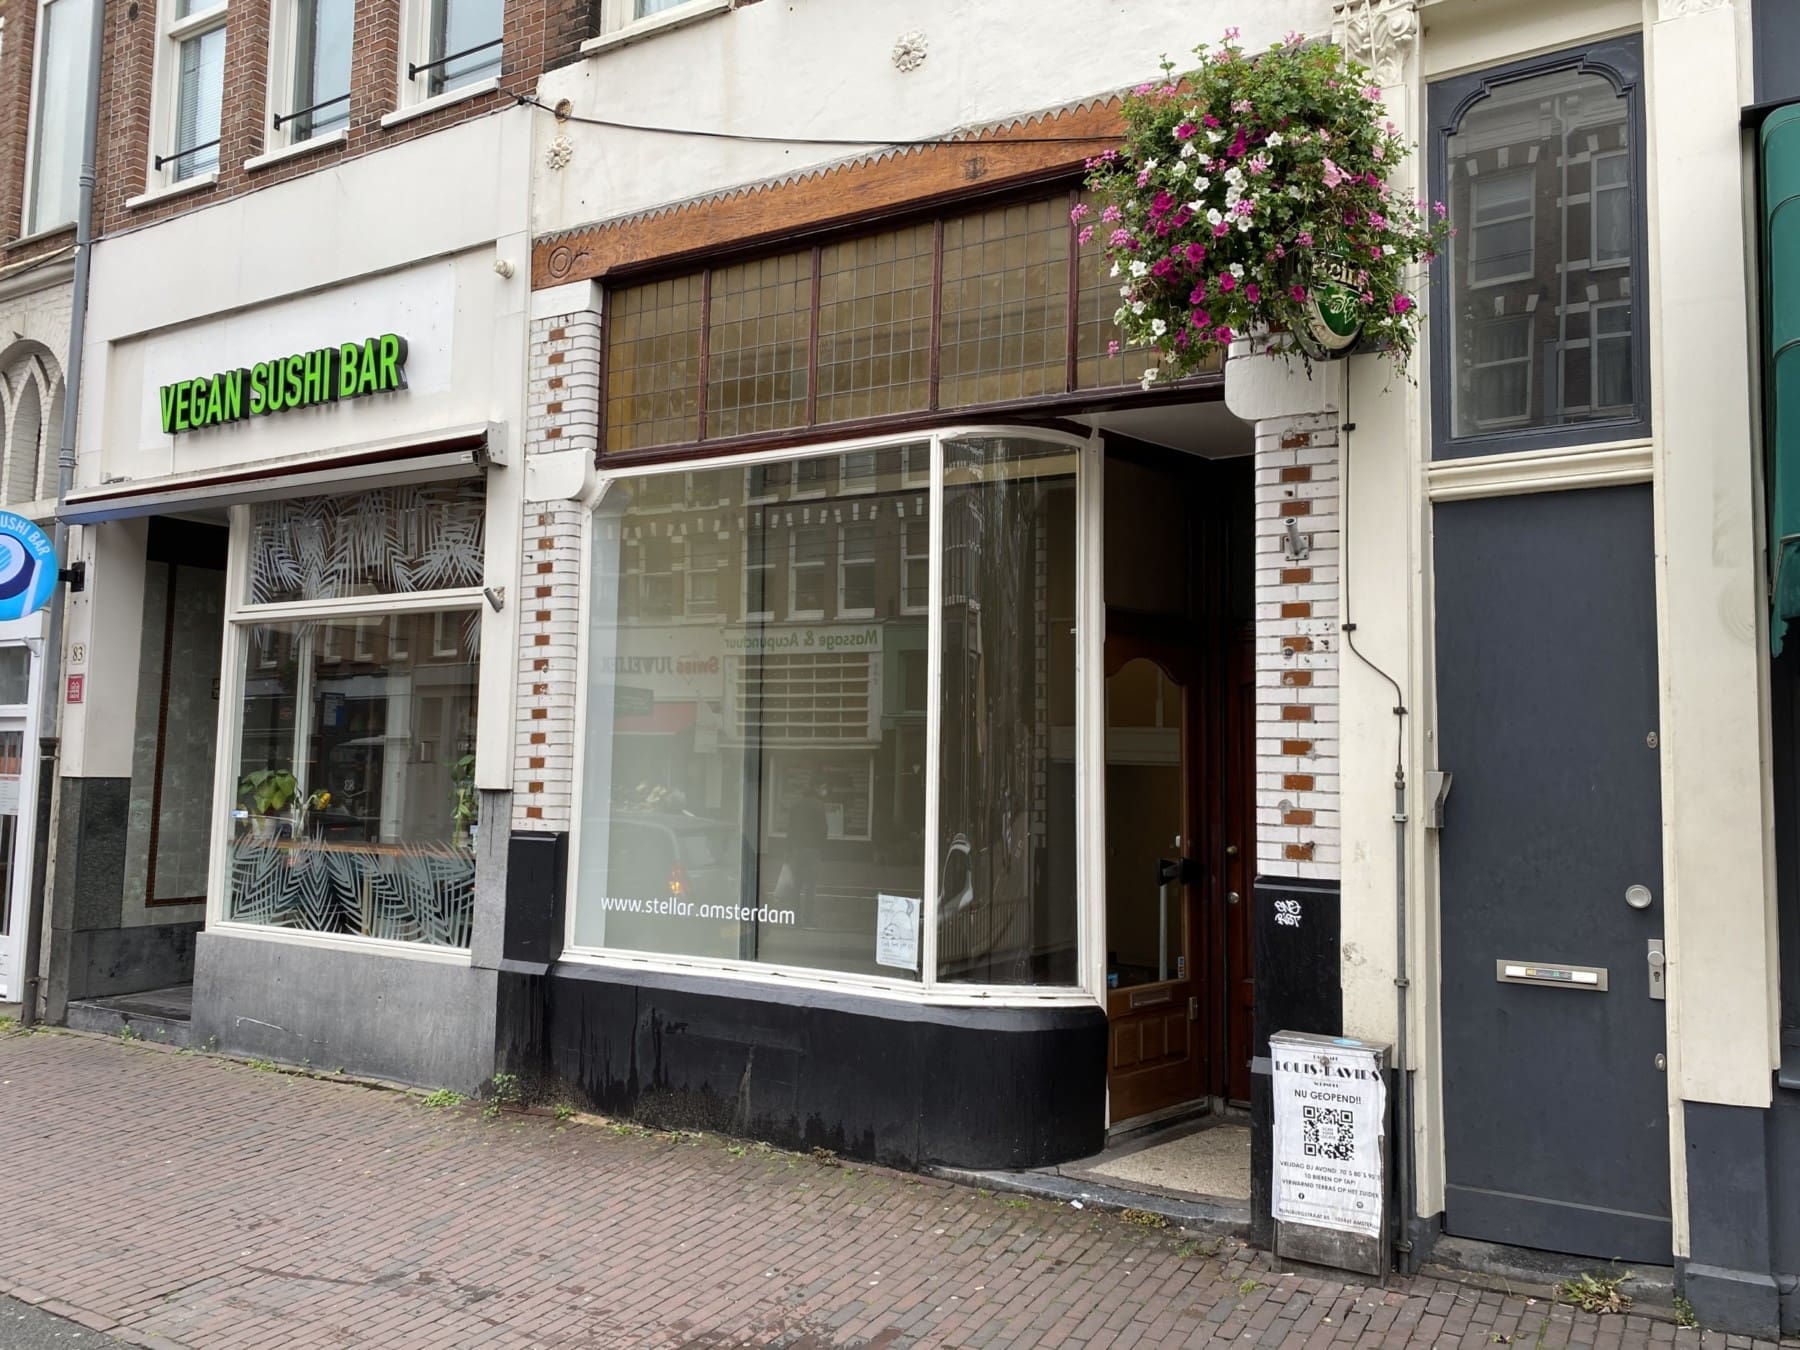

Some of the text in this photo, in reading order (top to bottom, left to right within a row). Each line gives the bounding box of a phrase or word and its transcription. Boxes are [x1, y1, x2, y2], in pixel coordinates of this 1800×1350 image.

[160, 333, 402, 433] VEGAN SUSHI BAR
[0, 514, 50, 556] USHI BAR
[72, 646, 83, 661] 83
[1294, 1089, 1361, 1104] NU GEOPEND!!
